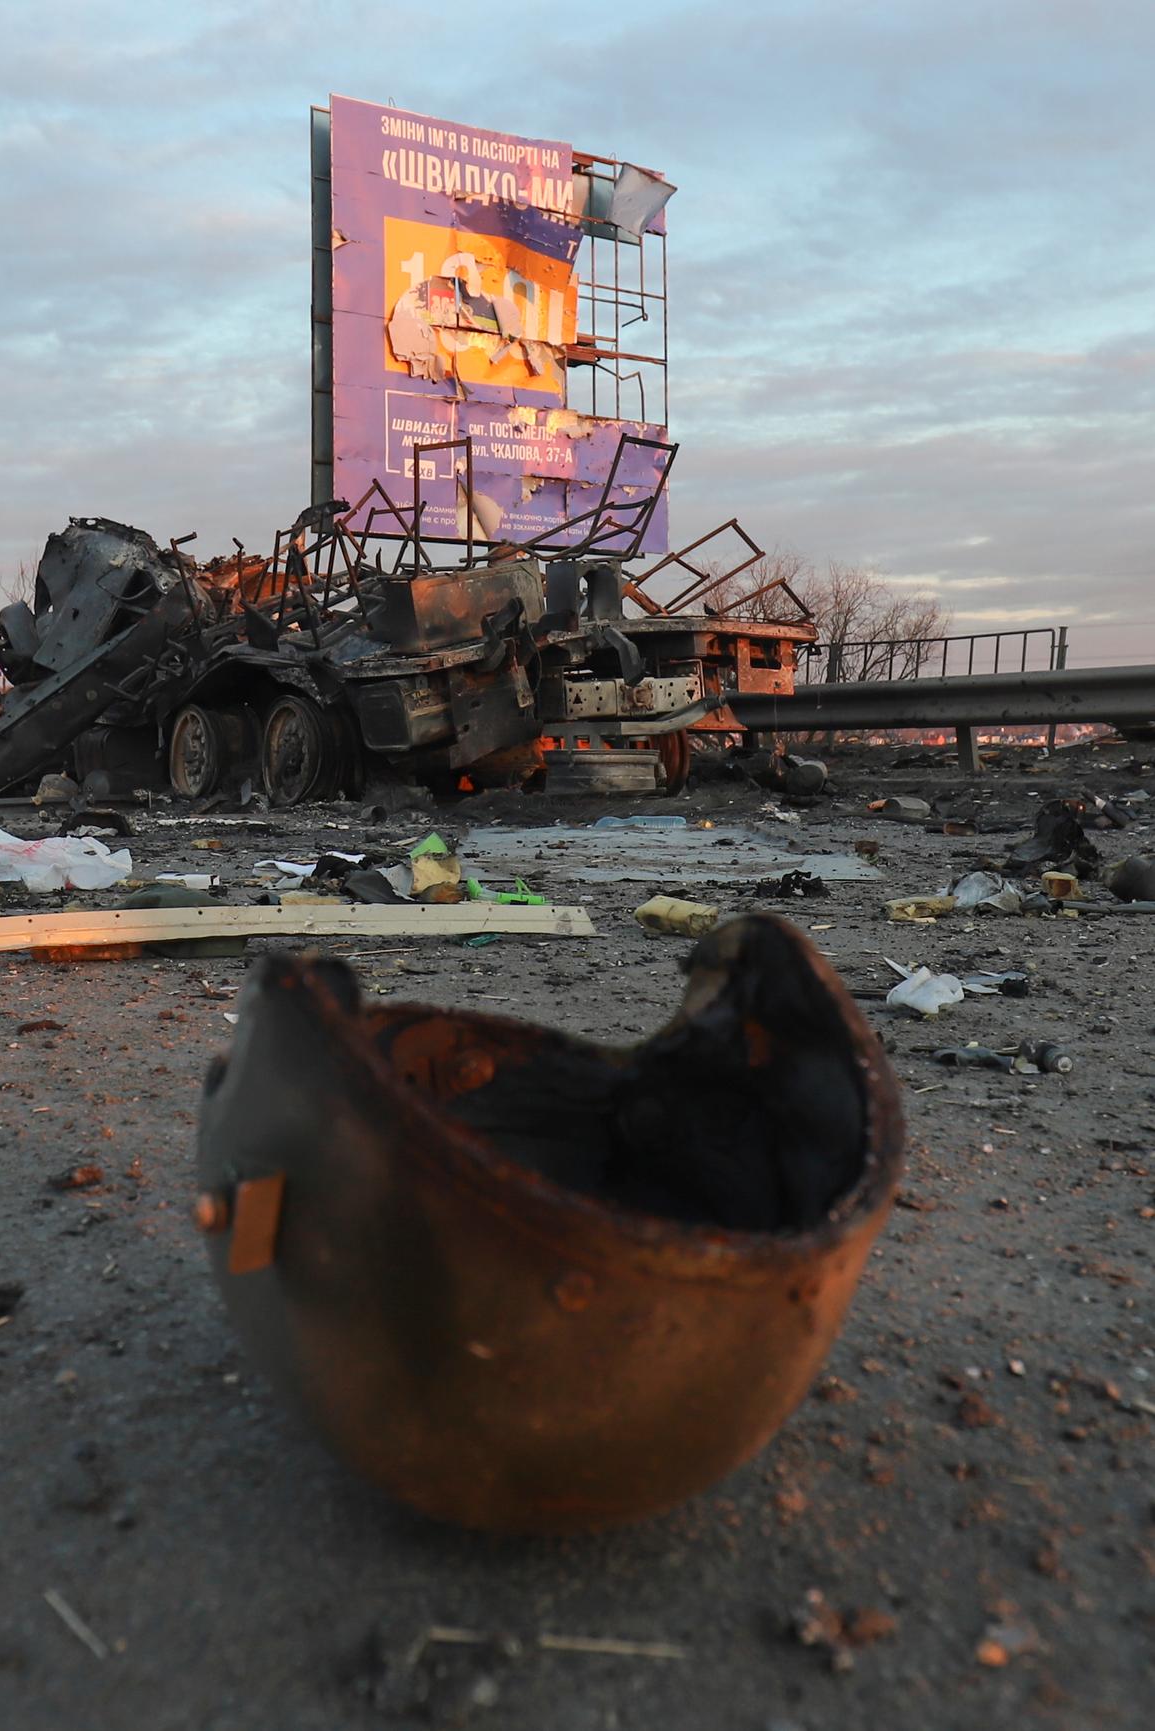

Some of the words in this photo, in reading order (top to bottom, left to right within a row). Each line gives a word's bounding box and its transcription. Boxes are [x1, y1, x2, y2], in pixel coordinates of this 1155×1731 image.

[381, 115, 425, 143] ЗМІНИ
[428, 127, 457, 151] ІМ'Я
[461, 135, 469, 154] В
[472, 137, 538, 165] ПАСПОРТІ
[542, 148, 560, 169] НА
[392, 418, 448, 436] ШВИДКО
[490, 442, 543, 463] ЧКАЛОВА,
[546, 447, 573, 463] 37-А
